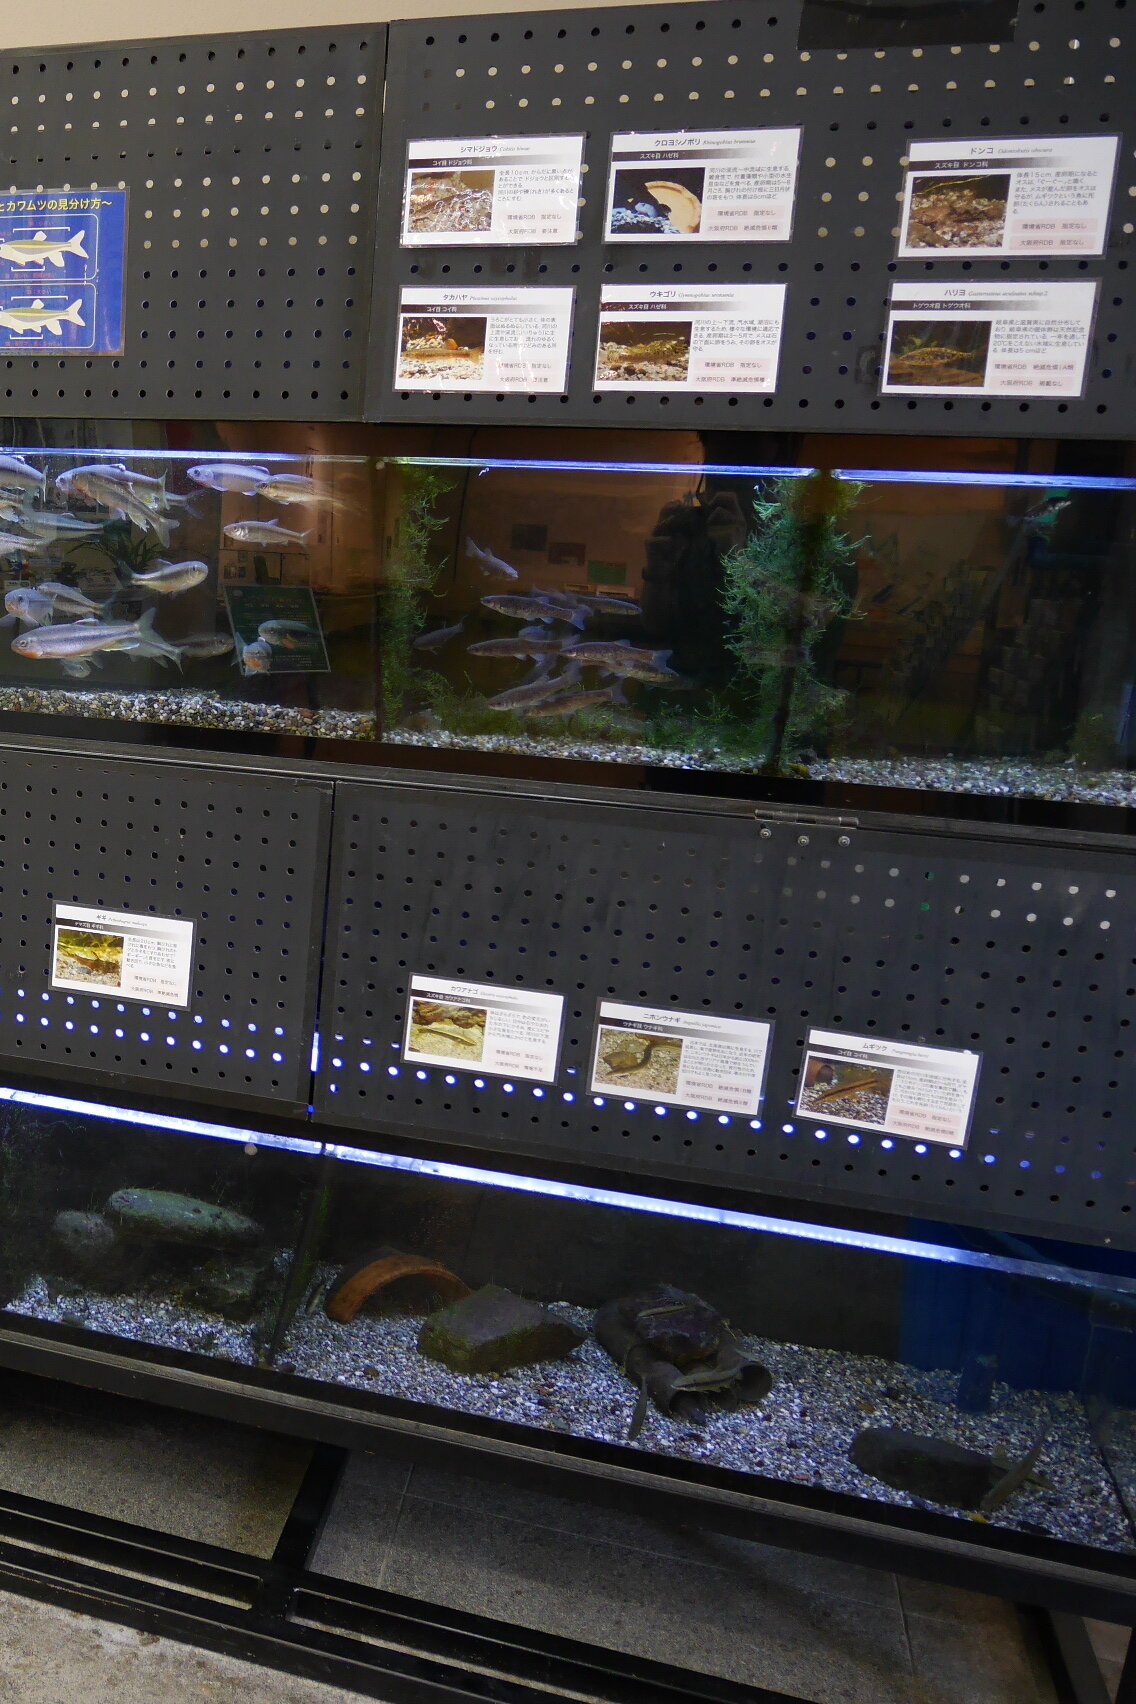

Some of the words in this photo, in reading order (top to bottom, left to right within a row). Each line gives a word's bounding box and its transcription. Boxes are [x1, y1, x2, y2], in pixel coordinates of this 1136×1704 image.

[654, 138, 701, 147] クロヨシノボリ
[460, 145, 498, 154] シマドジョウ
[969, 146, 994, 155] ドンコ
[442, 293, 468, 301] タカハヤ
[649, 290, 676, 298] ウキゴリ
[943, 288, 966, 297] ハリヨ
[450, 985, 479, 995] カワアナゴ
[643, 1012, 681, 1024] ニホンウナギ
[862, 1042, 888, 1052] ムギツク
